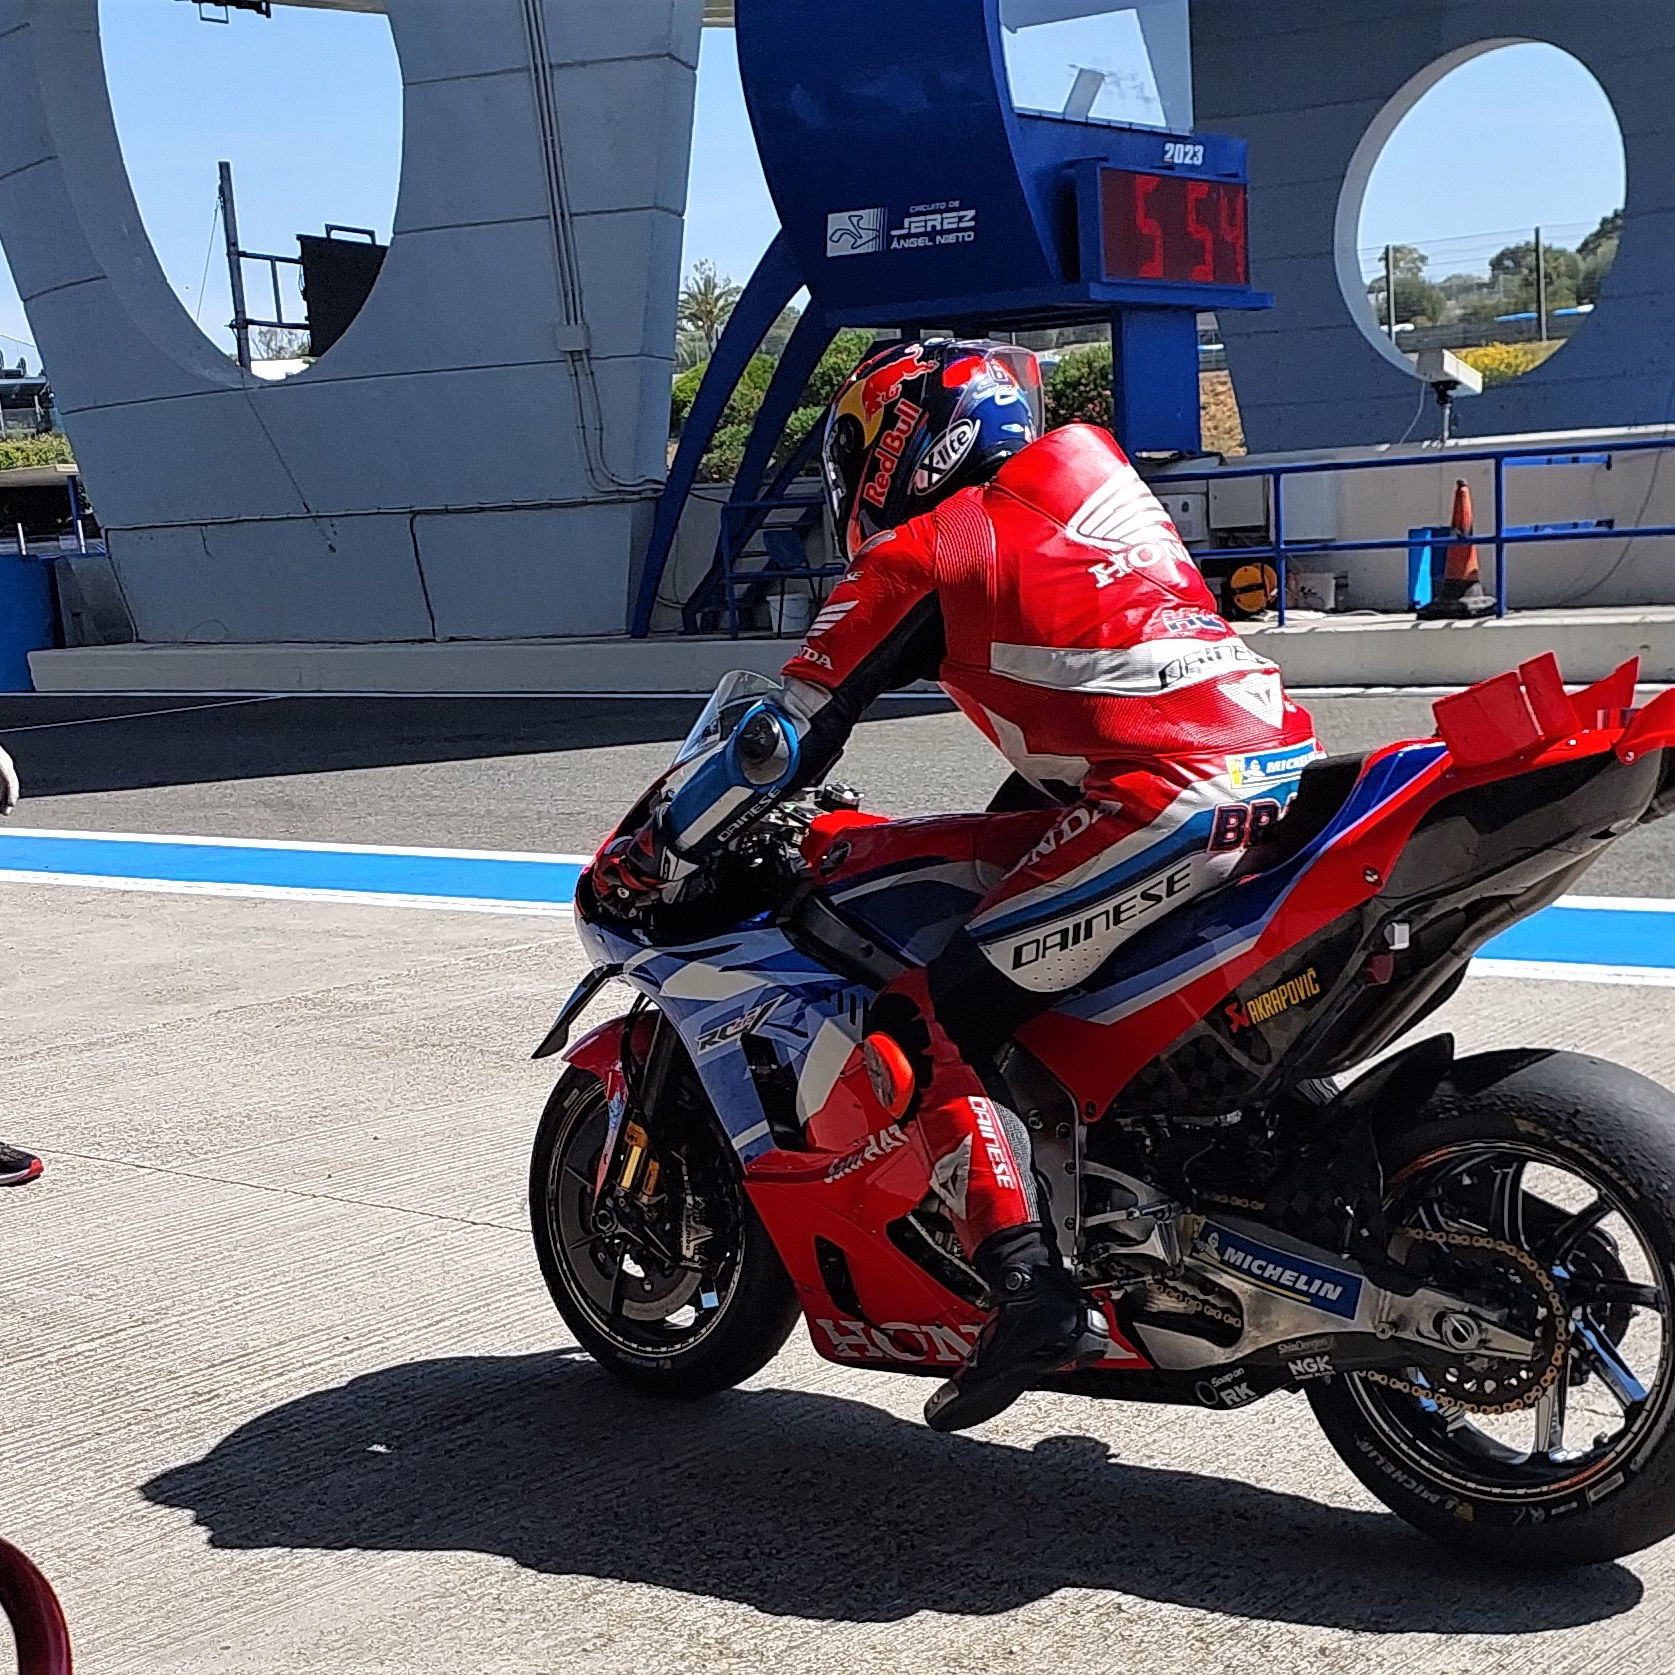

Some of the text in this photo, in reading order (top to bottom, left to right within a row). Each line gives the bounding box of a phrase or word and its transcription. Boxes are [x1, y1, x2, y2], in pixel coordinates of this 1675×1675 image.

[1163, 143, 1204, 165] 2023
[890, 209, 976, 236] JEREZ
[936, 231, 975, 245] NIETO
[863, 398, 923, 508] Red Bull
[717, 786, 782, 843] DAINESE
[1011, 863, 1192, 970] DAINESE
[1247, 967, 1320, 1024] AKRAPOVIČ
[968, 1096, 1016, 1190] DAINESE
[1223, 1246, 1343, 1301] MICHELIN
[1288, 1355, 1334, 1376] NGK
[1219, 1382, 1257, 1407] RK
